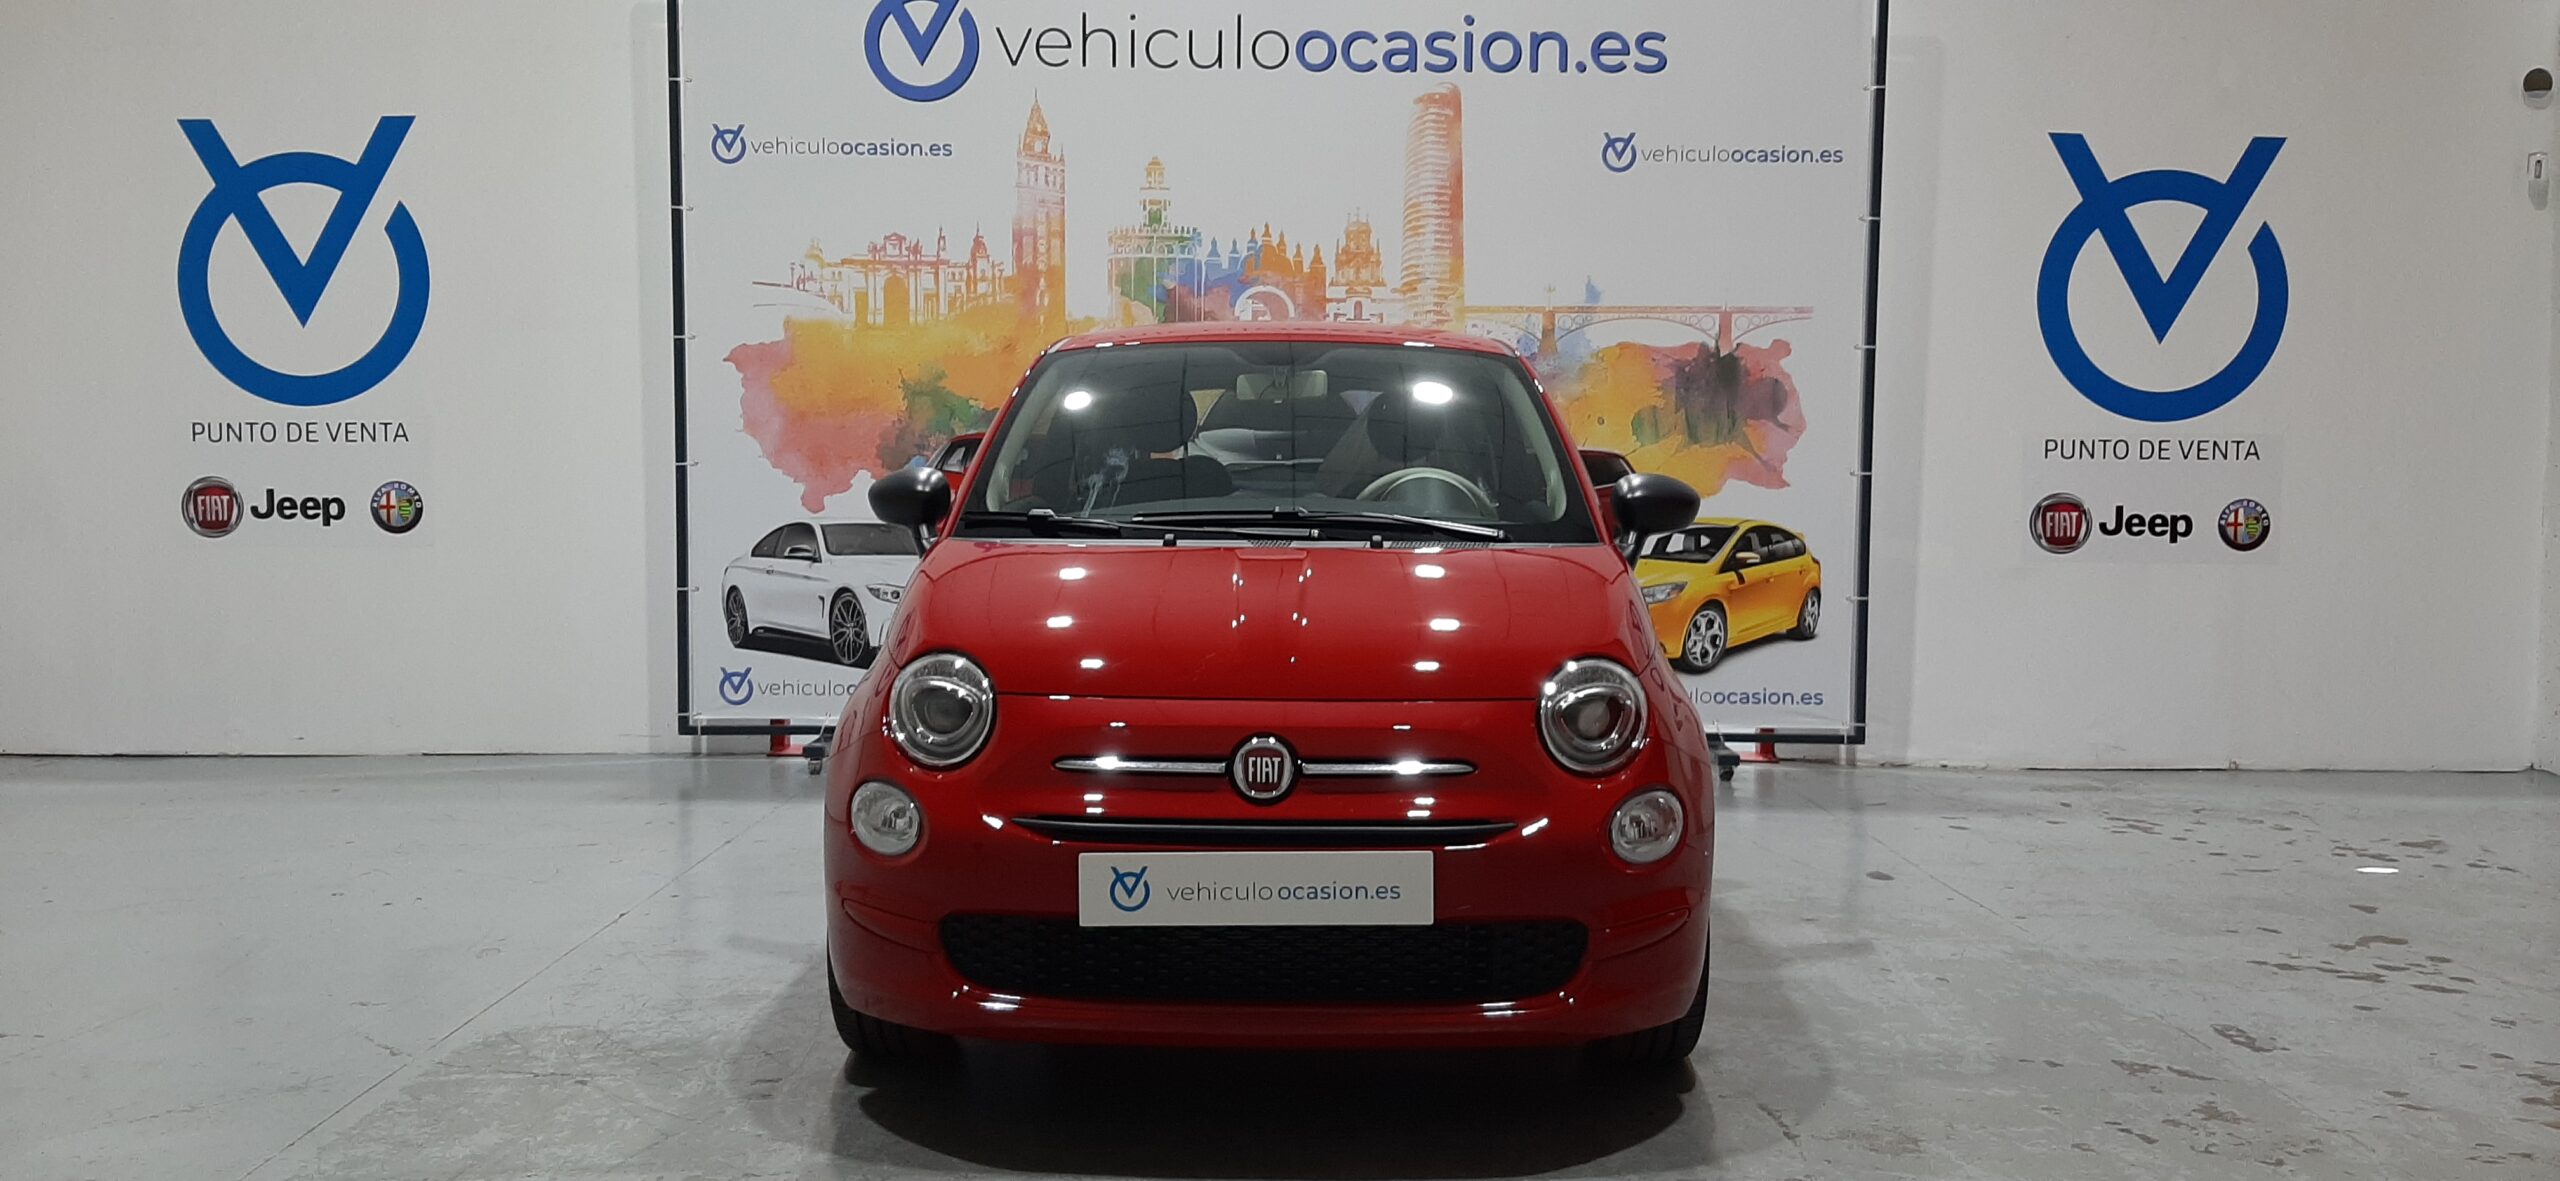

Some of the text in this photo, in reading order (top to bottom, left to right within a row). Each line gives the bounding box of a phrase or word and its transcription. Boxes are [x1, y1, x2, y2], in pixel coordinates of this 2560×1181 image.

[995, 11, 1668, 75] vehiculoocasion.es
[750, 135, 953, 158] vehiculoocasion.es
[1640, 144, 1844, 164] vehiculoocasion.es
[191, 421, 410, 444] PUNTO DE VENTA
[2044, 438, 2261, 462] PUNTO DE VENTA
[197, 495, 231, 521] FIAT
[250, 488, 346, 527] Jeep
[2045, 511, 2079, 538] FIAT
[2098, 504, 2194, 544] Jeep
[1248, 757, 1281, 783] FIAT
